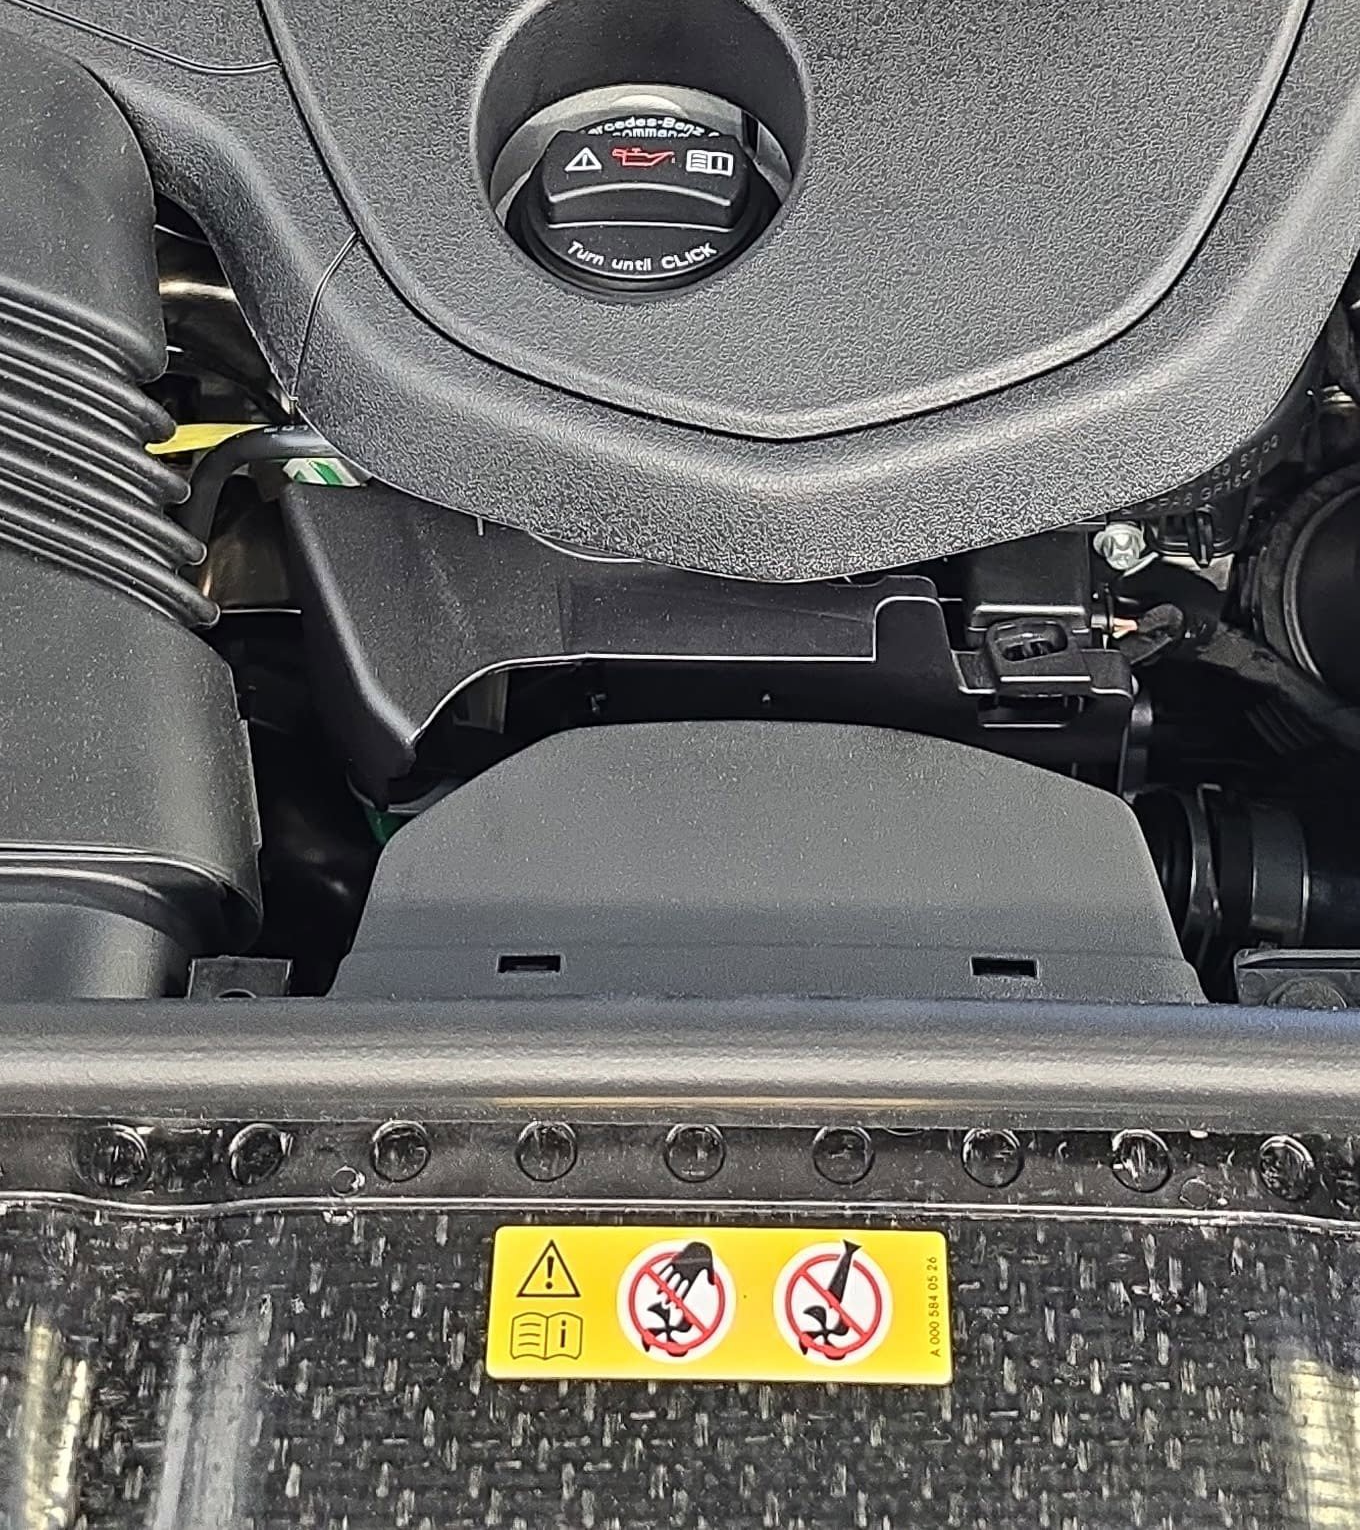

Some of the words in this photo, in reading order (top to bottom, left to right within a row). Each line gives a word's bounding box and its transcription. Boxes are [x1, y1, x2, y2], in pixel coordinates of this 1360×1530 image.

[584, 116, 705, 136] ercedes-Benz
[567, 240, 606, 267] Turn
[611, 257, 652, 271] until
[660, 241, 718, 270] CLICK
[926, 1256, 937, 1271] 26
[927, 1275, 938, 1291] 05
[928, 1295, 939, 1317] 584
[929, 1321, 940, 1344] 000
[930, 1349, 941, 1357] A
